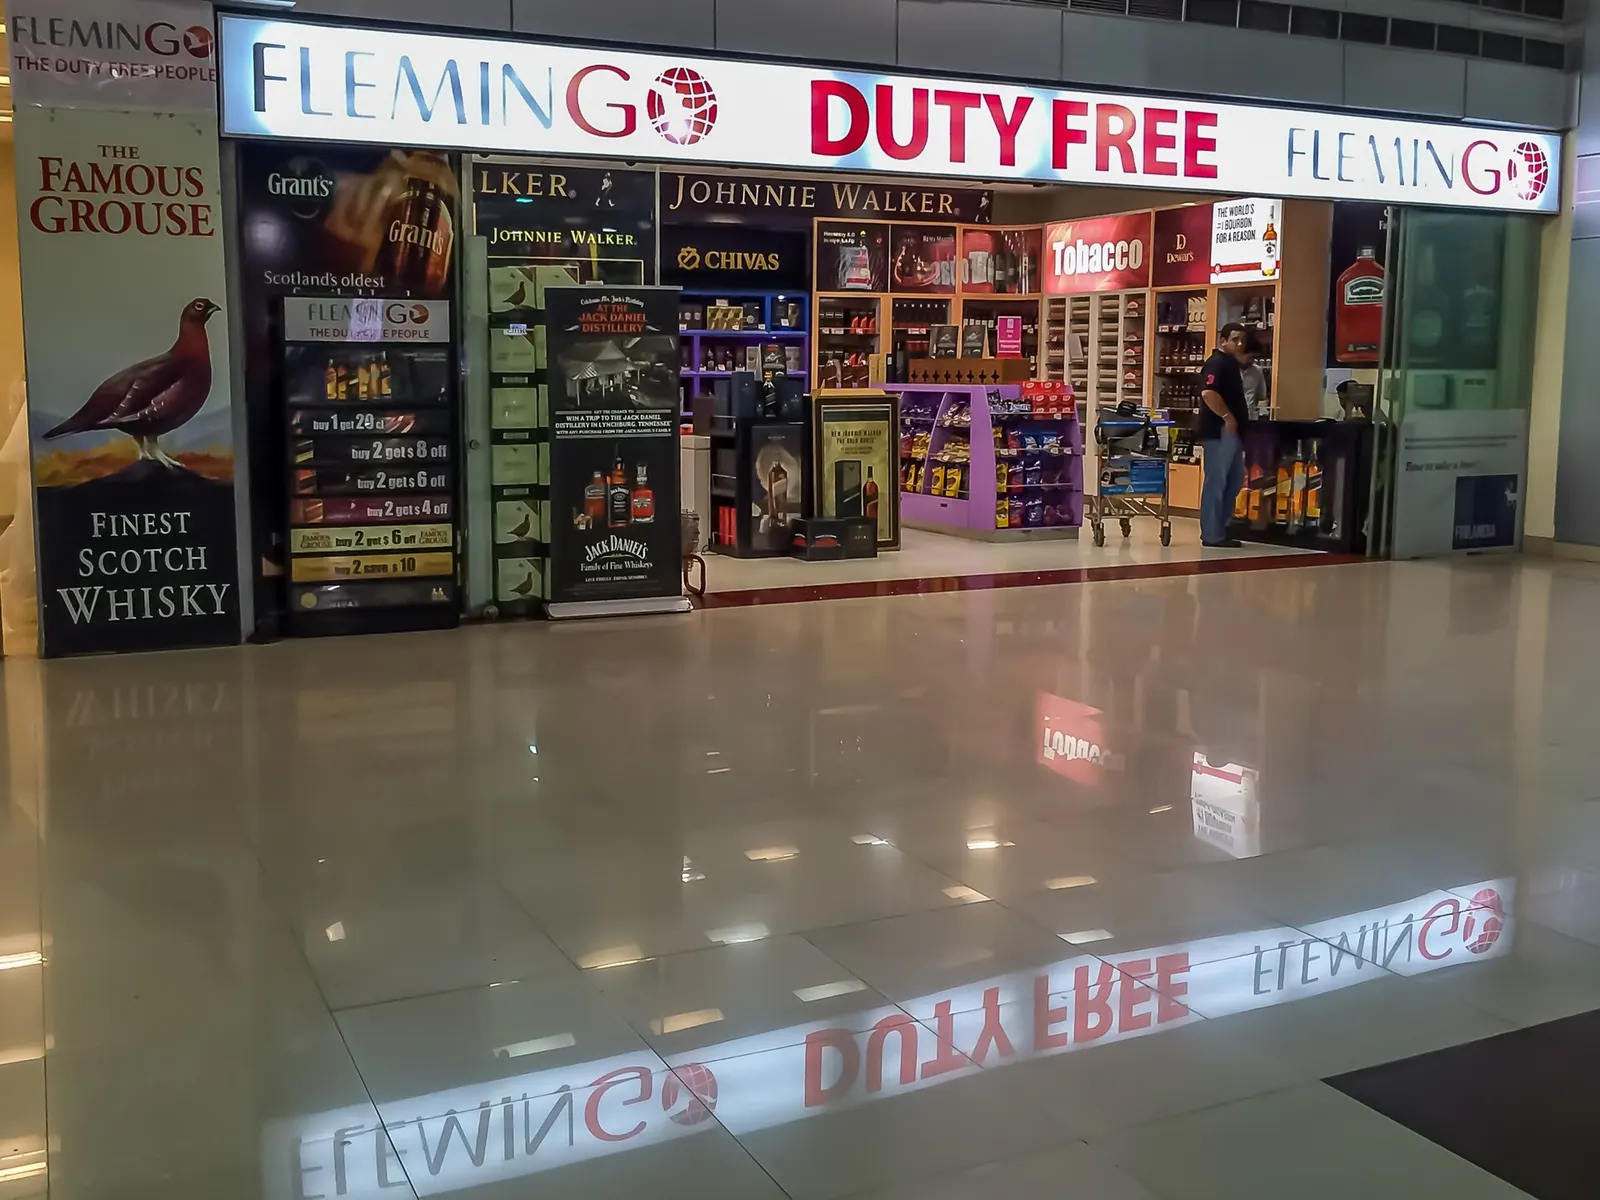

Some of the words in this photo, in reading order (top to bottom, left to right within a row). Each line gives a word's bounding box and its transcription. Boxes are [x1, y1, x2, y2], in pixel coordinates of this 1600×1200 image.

[15, 55, 49, 72] THE
[55, 57, 101, 76] DUTY
[155, 64, 216, 83] PEOPLE
[810, 79, 1035, 167] DUTY
[1050, 99, 1218, 179] FREE
[97, 145, 140, 160] THE
[37, 156, 204, 198] FAMOUS
[267, 173, 330, 197] Grant's
[472, 171, 568, 197] LKER
[669, 175, 816, 210] JOHNNIE
[832, 183, 953, 214] WALKER
[30, 196, 214, 237] GROUSE
[1217, 207, 1228, 217] THE
[1225, 218, 1253, 230] BOURBON
[490, 227, 562, 244] JOHNNIE
[571, 230, 634, 245] WALKER
[1216, 233, 1227, 243] FOR
[1228, 232, 1232, 242] A
[705, 251, 780, 270] CHIVAS
[1053, 239, 1143, 275] Tobacco
[264, 271, 337, 287] Scotland's
[341, 273, 385, 287] oldest
[579, 313, 607, 322] JACK
[610, 313, 648, 322] DANIEL
[310, 328, 330, 338] THE
[391, 329, 430, 338] PEOPLE
[582, 323, 644, 333] DISTILLERY
[313, 420, 329, 431] buy
[331, 414, 338, 430] 1
[340, 421, 354, 431] get
[352, 448, 370, 460] buy
[372, 441, 383, 459] 2
[416, 440, 427, 458] 8
[431, 445, 447, 457] off
[357, 479, 375, 489] buy
[376, 472, 386, 488] 2
[417, 471, 427, 487] 6
[430, 475, 446, 487] off
[385, 501, 394, 516] 2
[422, 500, 431, 514] 4
[434, 503, 448, 514] off
[91, 511, 191, 537] FINEST
[355, 531, 364, 546] 2
[392, 529, 402, 545] 6
[585, 540, 610, 562] JACK
[610, 535, 649, 560] DANIEL'S
[78, 546, 208, 577] SCOTCH
[353, 560, 362, 575] 2
[400, 557, 416, 573] 10
[56, 583, 230, 625] WHISKY
